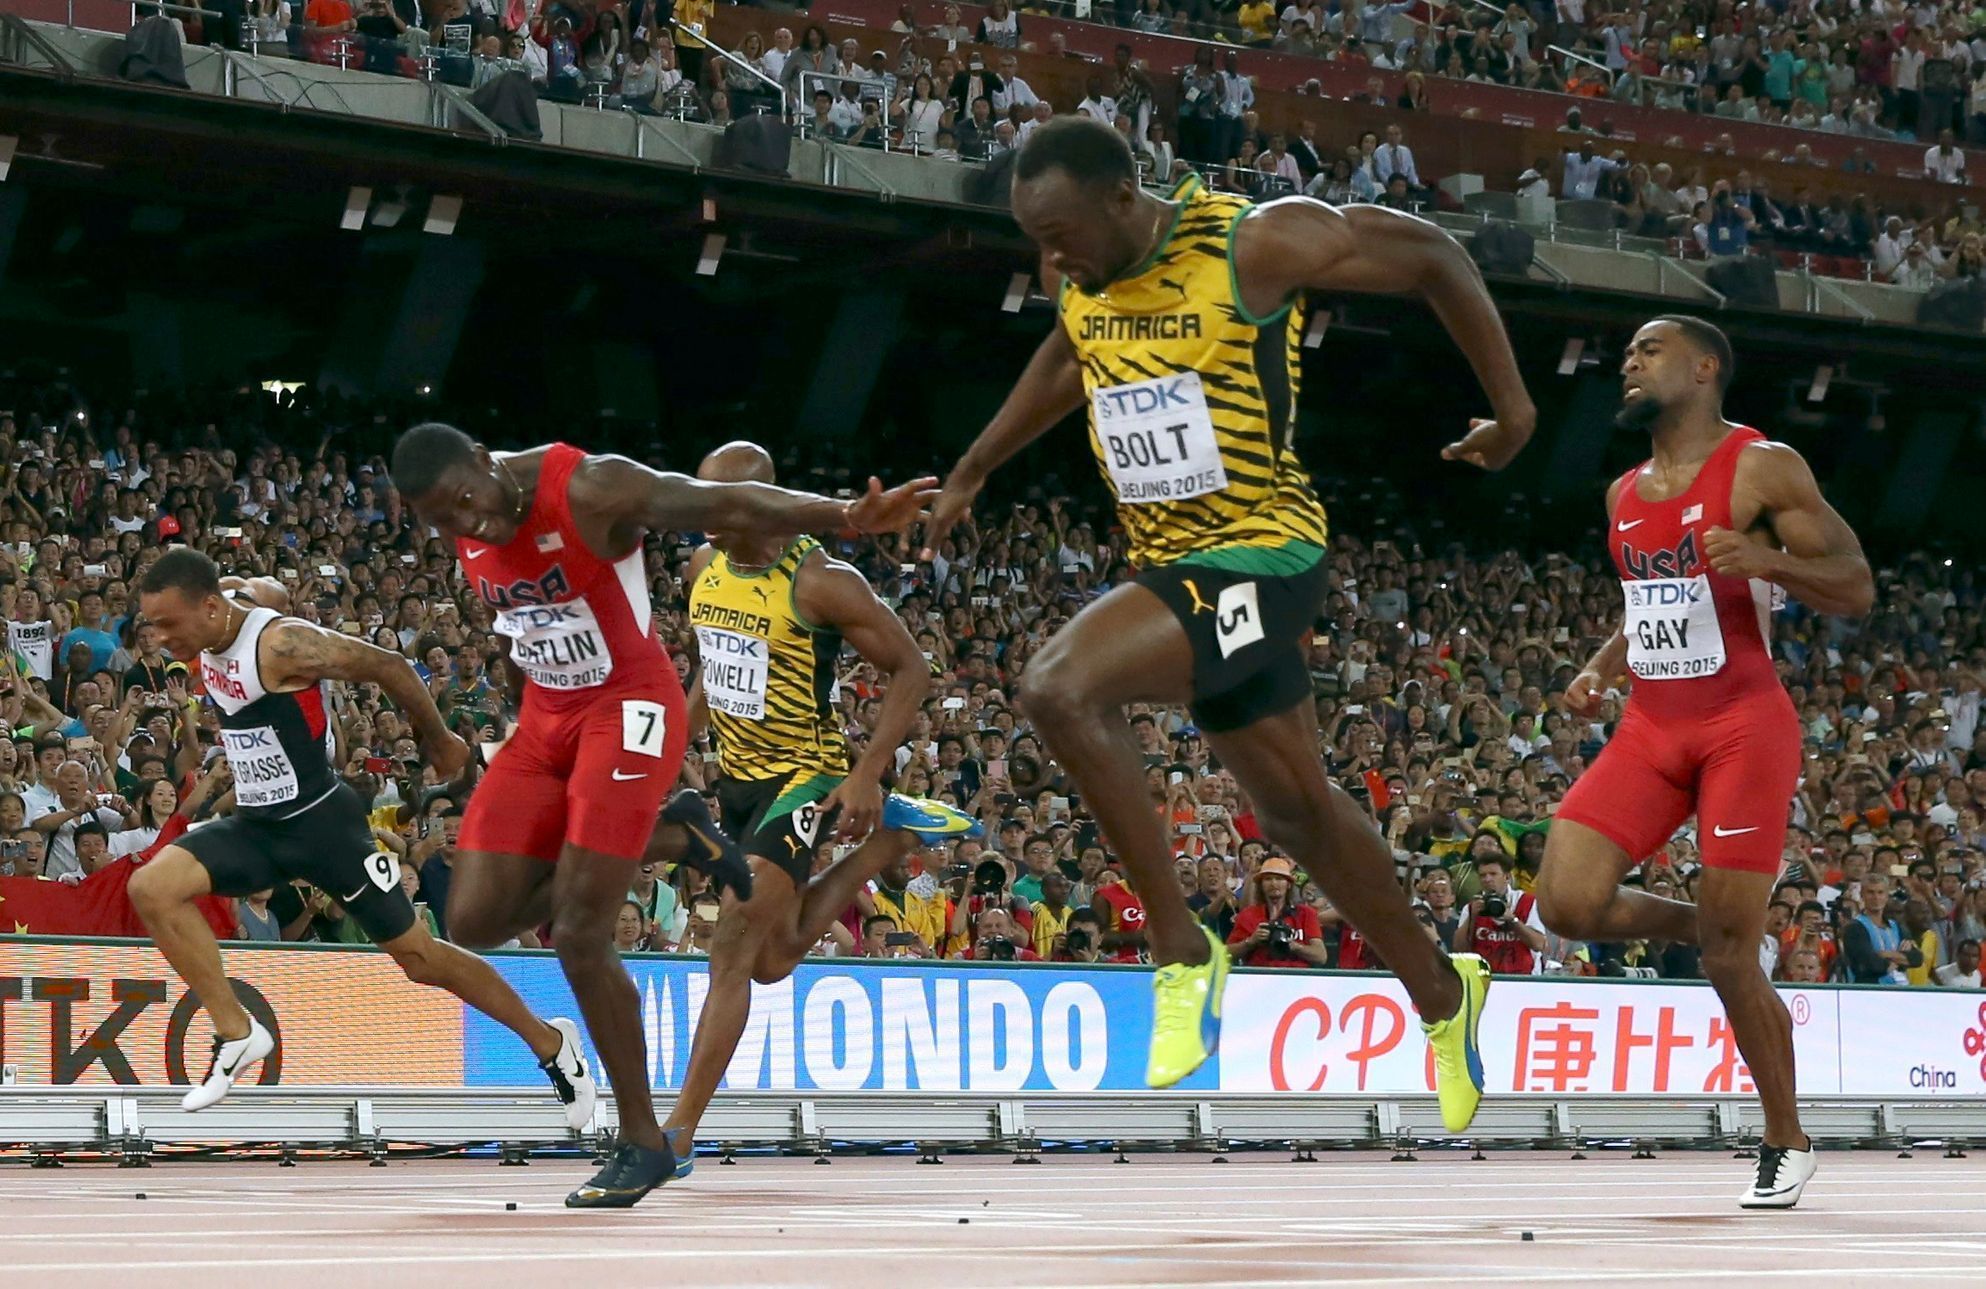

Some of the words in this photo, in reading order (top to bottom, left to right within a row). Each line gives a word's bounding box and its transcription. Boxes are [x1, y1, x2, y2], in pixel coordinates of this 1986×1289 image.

[1079, 314, 1201, 340] JAMAICA
[1106, 379, 1190, 415] TDK
[1108, 423, 1189, 469] BOLT
[1121, 480, 1170, 499] BEIJING
[1174, 470, 1216, 495] 2015
[1622, 527, 1699, 580] USA
[478, 563, 570, 608] USA
[1640, 583, 1699, 606] TDK
[16, 626, 45, 638] 1892
[514, 605, 581, 632] TDK
[692, 603, 771, 635] JAMAICA
[1219, 603, 1249, 636] 5
[711, 632, 759, 658] TDK
[1638, 618, 1689, 650] GAY
[572, 667, 606, 686] 2015
[1683, 657, 1718, 674] 2015
[731, 701, 760, 715] 2015
[229, 730, 272, 750] TDK
[638, 710, 656, 746] 7
[271, 784, 295, 801] 2015
[801, 806, 815, 834] 8
[376, 855, 392, 884] 9
[687, 973, 1107, 1090] MONDO
[1909, 1064, 1956, 1090] China
